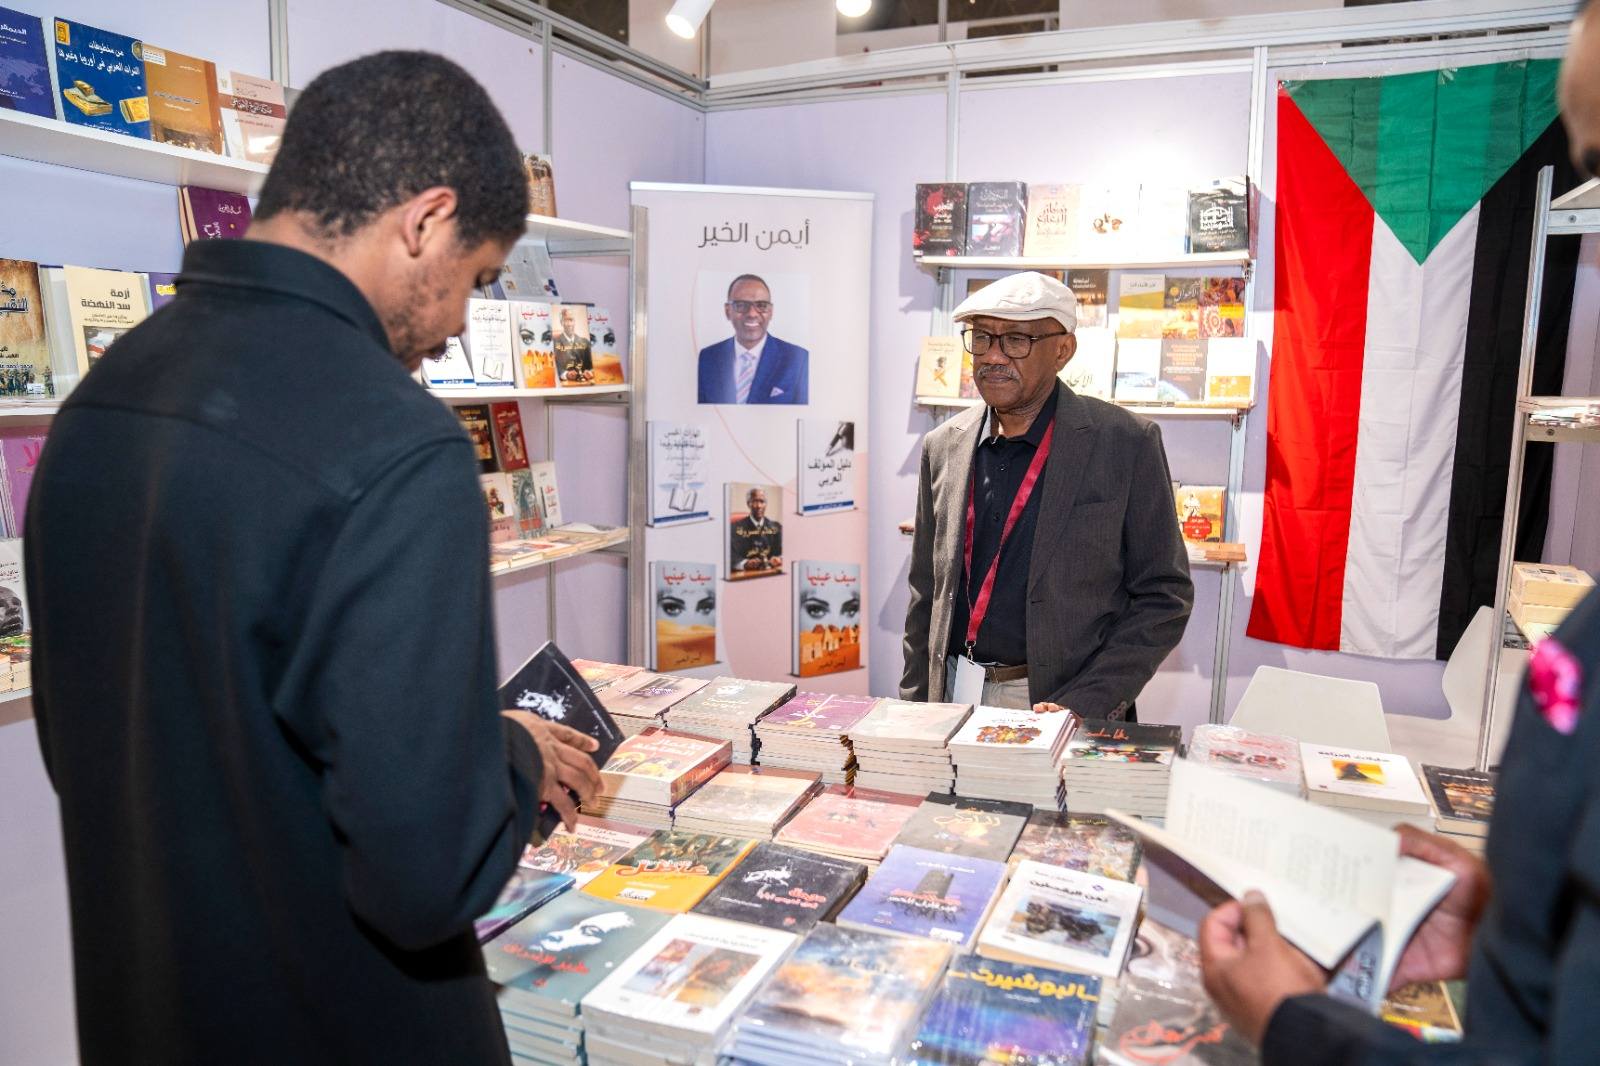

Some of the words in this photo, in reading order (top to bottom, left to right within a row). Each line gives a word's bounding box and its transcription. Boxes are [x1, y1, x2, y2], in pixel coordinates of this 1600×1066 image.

[97, 58, 106, 70] في
[697, 221, 748, 249] الخير
[755, 219, 810, 250] أيمن
[110, 287, 130, 298] أزمة
[81, 298, 115, 310] النهضة
[117, 302, 131, 311] سد
[808, 458, 835, 472] المؤلف
[837, 458, 852, 471] دليل
[818, 472, 842, 488] العربي
[689, 569, 712, 586] سيف
[834, 569, 856, 587] سيف
